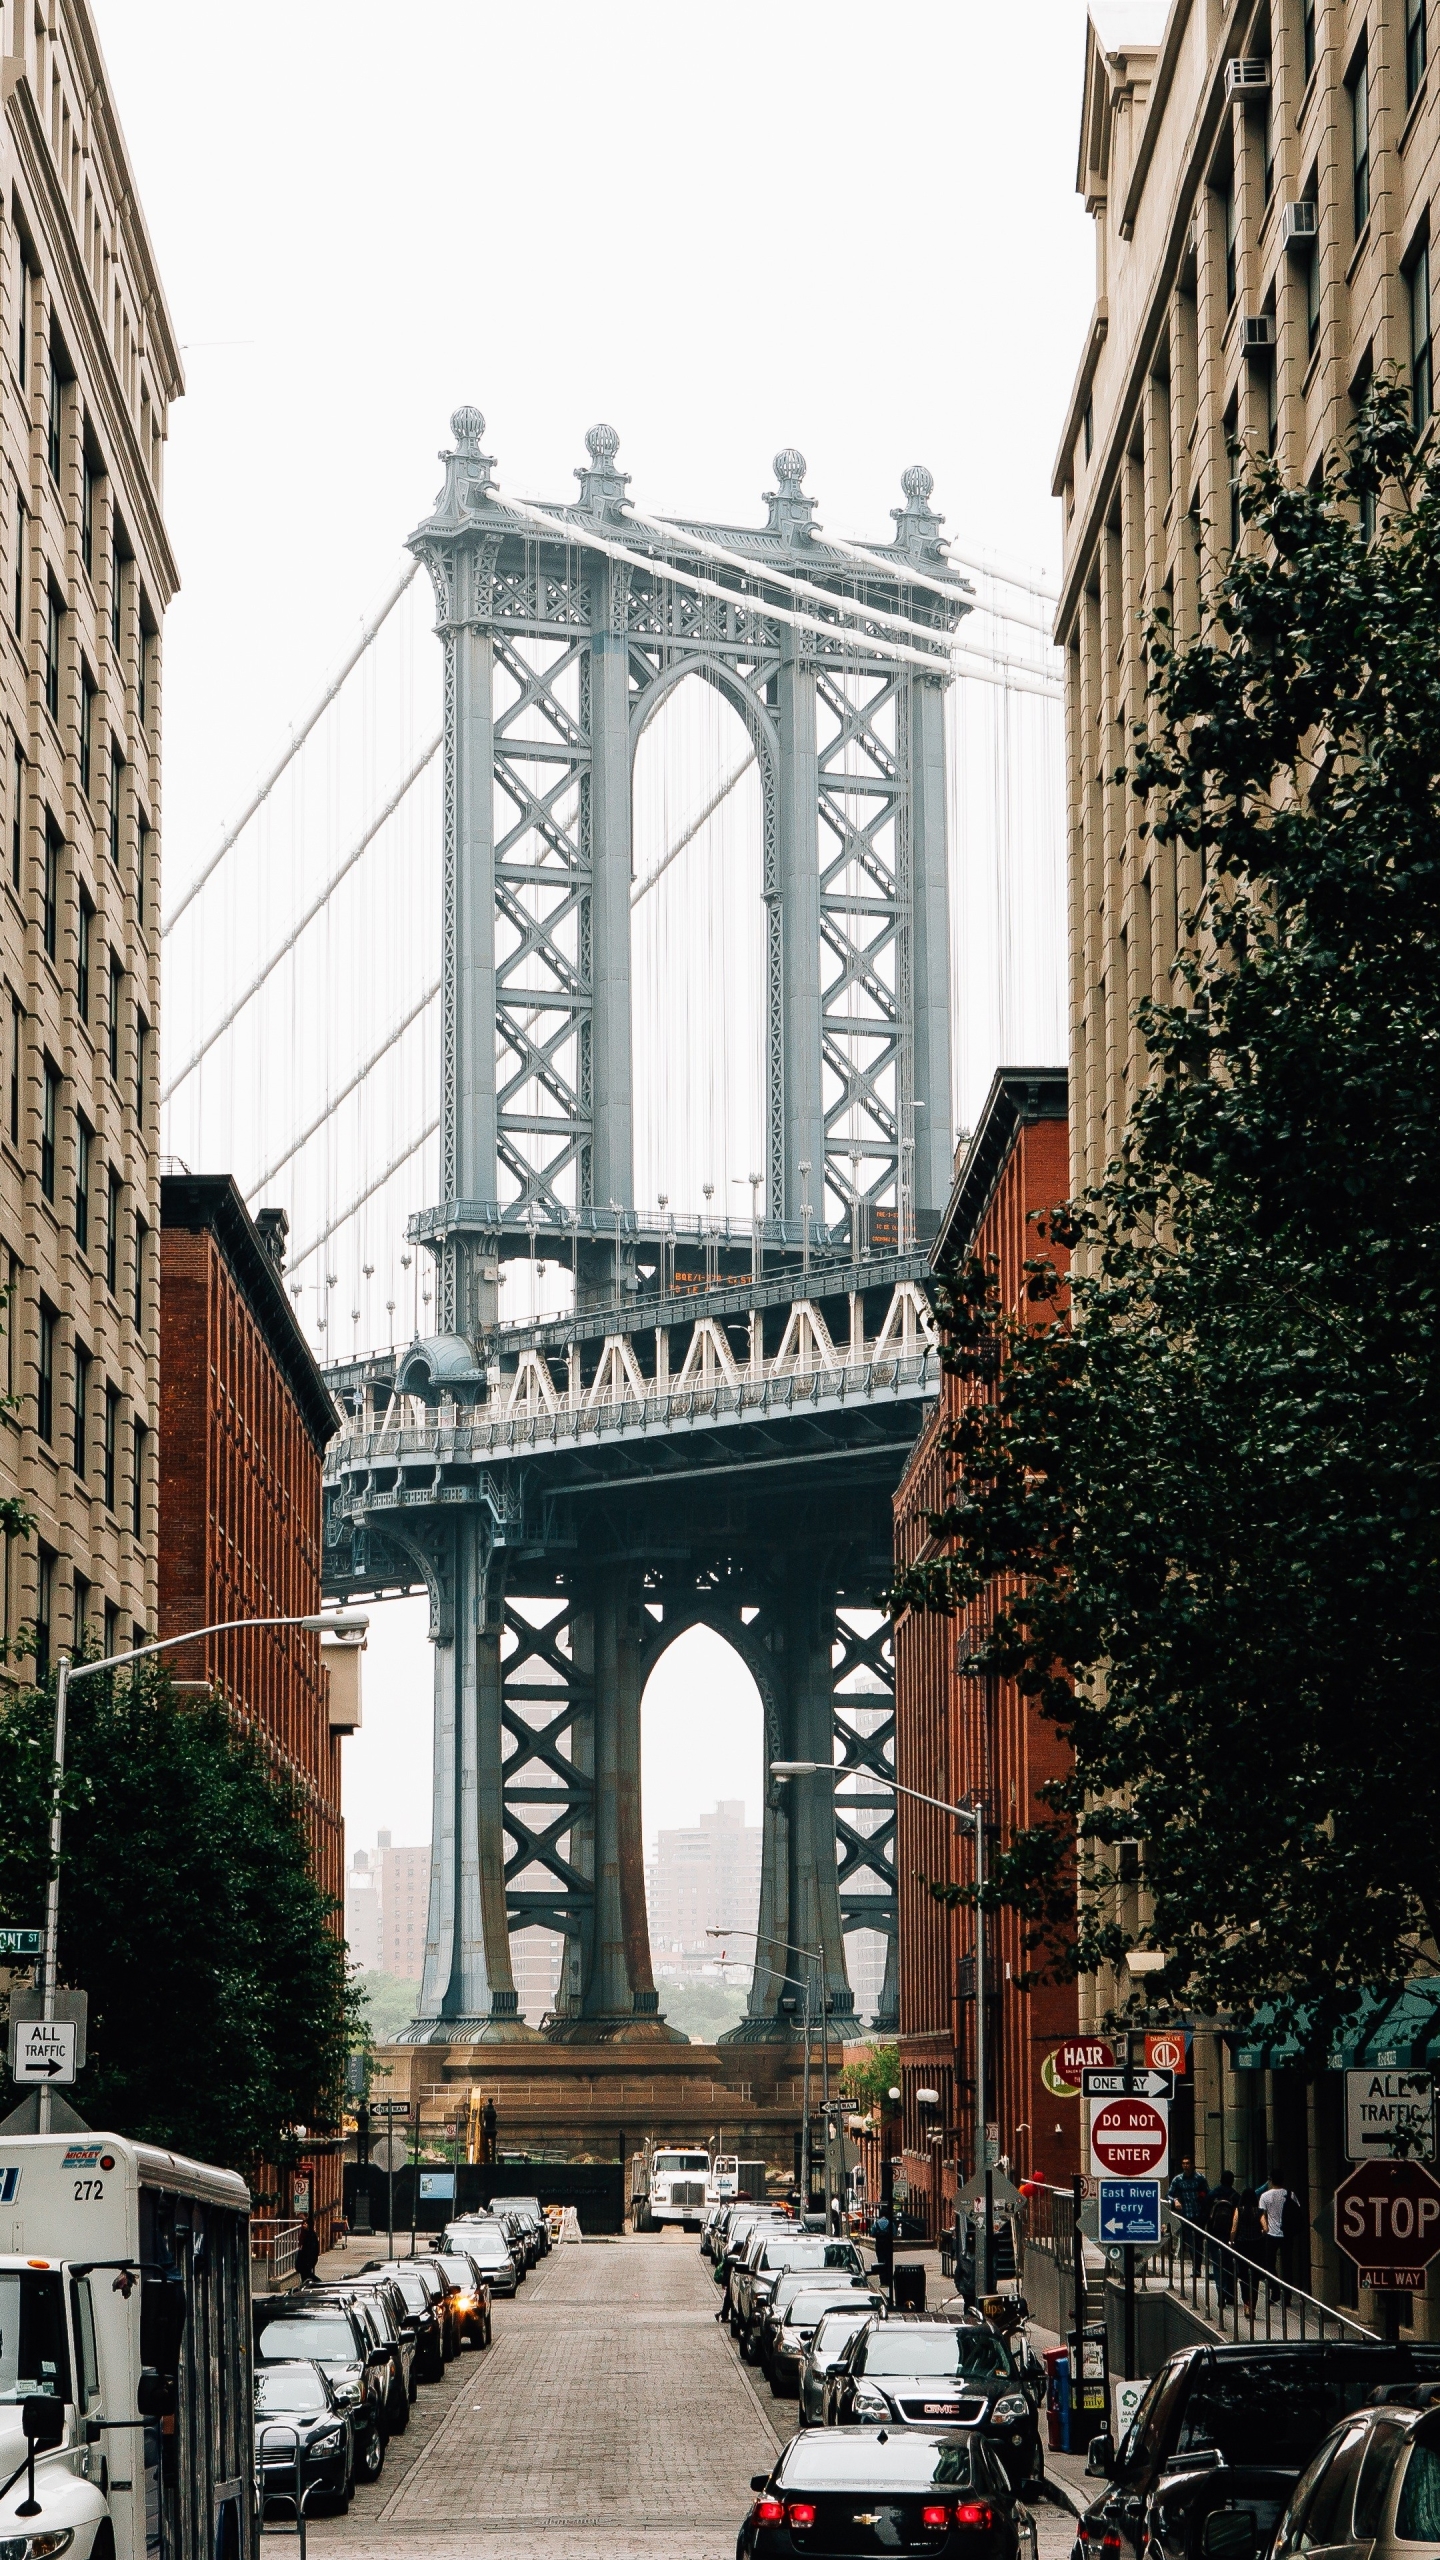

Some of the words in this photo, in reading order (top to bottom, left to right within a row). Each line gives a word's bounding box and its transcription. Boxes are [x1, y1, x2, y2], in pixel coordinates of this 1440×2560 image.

[28, 1933, 38, 1943] ST
[31, 2026, 61, 2041] ALL
[25, 2044, 66, 2057] TRAFFIC
[1063, 2046, 1104, 2066] HAIR
[1093, 2077, 1118, 2090] ONE
[1122, 2077, 1147, 2090] AY
[1368, 2076, 1411, 2098] ALL
[1359, 2103, 1422, 2122] TRAFFIC
[1102, 2114, 1121, 2127] DO
[1129, 2114, 1156, 2127] NOT
[65, 2151, 100, 2159] MICKEY
[1108, 2148, 1151, 2161] ENTER
[73, 2180, 104, 2201] 272
[1102, 2188, 1125, 2198] East
[1129, 2188, 1157, 2198] River
[1115, 2203, 1144, 2214] Ferry
[1343, 2196, 1440, 2239] STOP
[1365, 2272, 1389, 2286] ALL
[1395, 2272, 1422, 2286] WAY
[924, 2404, 960, 2414] GMC
